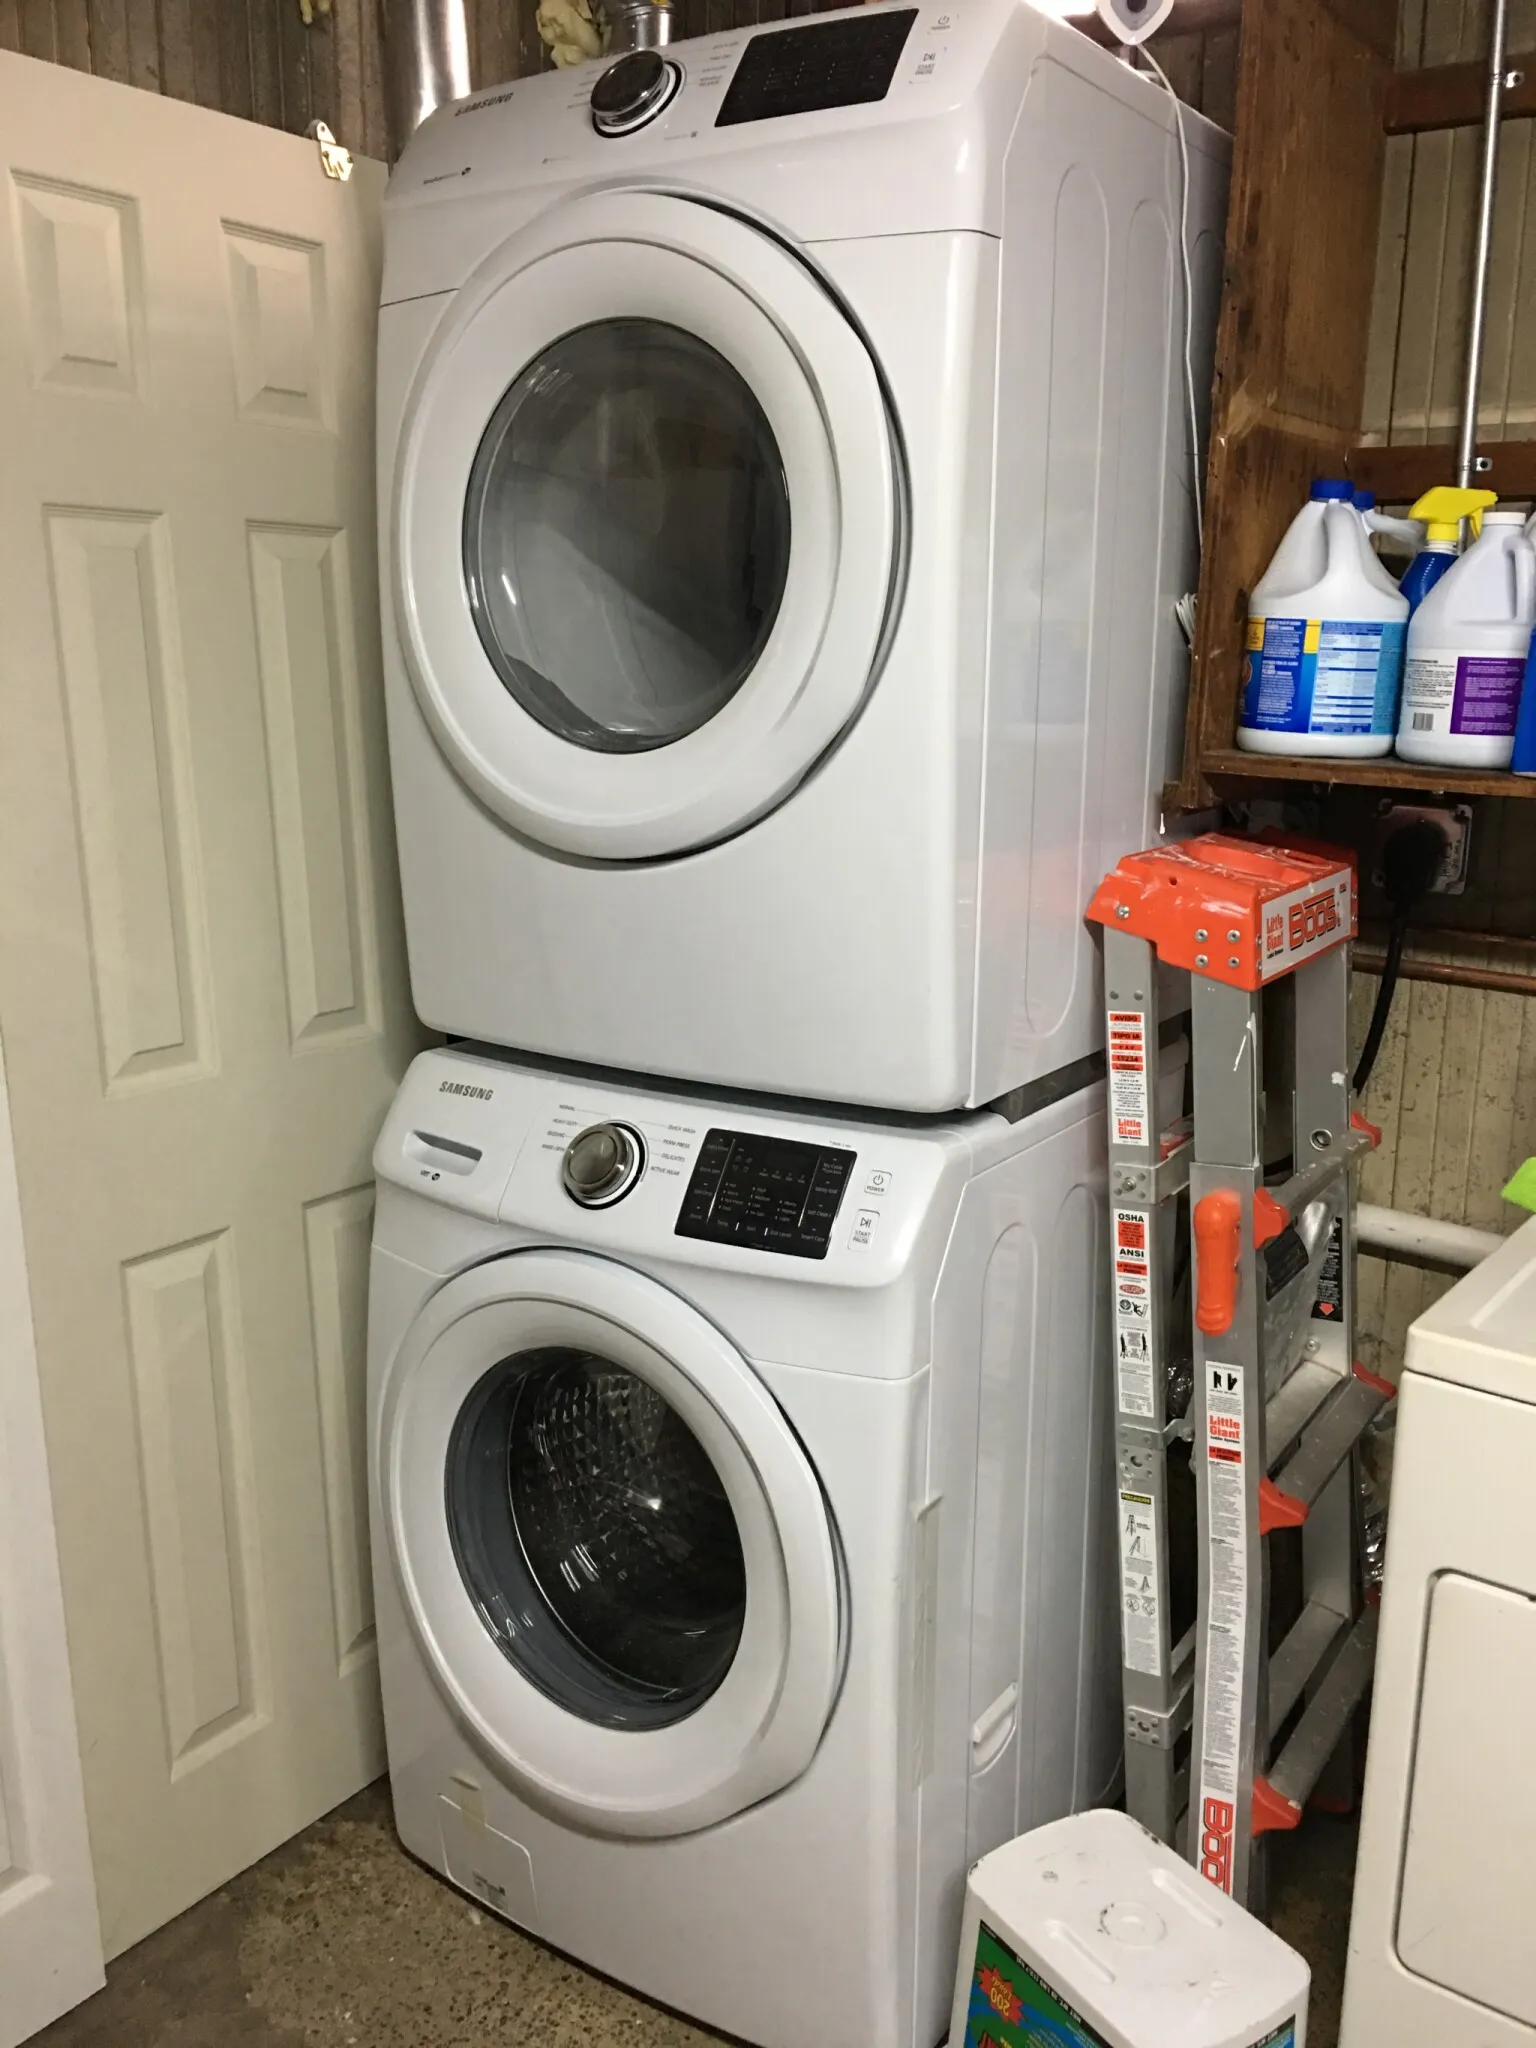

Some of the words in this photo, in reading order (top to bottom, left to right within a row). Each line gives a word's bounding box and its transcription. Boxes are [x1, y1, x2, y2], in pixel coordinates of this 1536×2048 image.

[455, 92, 514, 116] SAMSUNG
[1266, 913, 1284, 934] Little
[1266, 930, 1284, 952] Giant
[1114, 1014, 1138, 1022] AVISO
[439, 1081, 494, 1101] SAMSUNG
[1118, 1118, 1142, 1128] Little
[667, 1124, 681, 1133] QUICK
[682, 1127, 696, 1135] WASH
[1118, 1126, 1142, 1136] Giant
[663, 1138, 676, 1147] PERM
[676, 1141, 691, 1149] PRESS
[661, 1152, 686, 1163] DELICATES
[650, 1165, 666, 1175] ACTIVE
[666, 1169, 681, 1177] WEAR
[866, 1185, 885, 1193] POWER
[1118, 1212, 1145, 1223] OSHA
[801, 1233, 814, 1241] Smart
[814, 1235, 825, 1243] Care
[853, 1236, 869, 1244] PAUSE
[1119, 1248, 1145, 1258] ANSI
[1209, 1414, 1241, 1429] Little
[1209, 1425, 1241, 1439] Giant
[1201, 1797, 1234, 1896] BOO
[991, 1975, 1012, 2000] Loads
[990, 1987, 1010, 2017] 200
